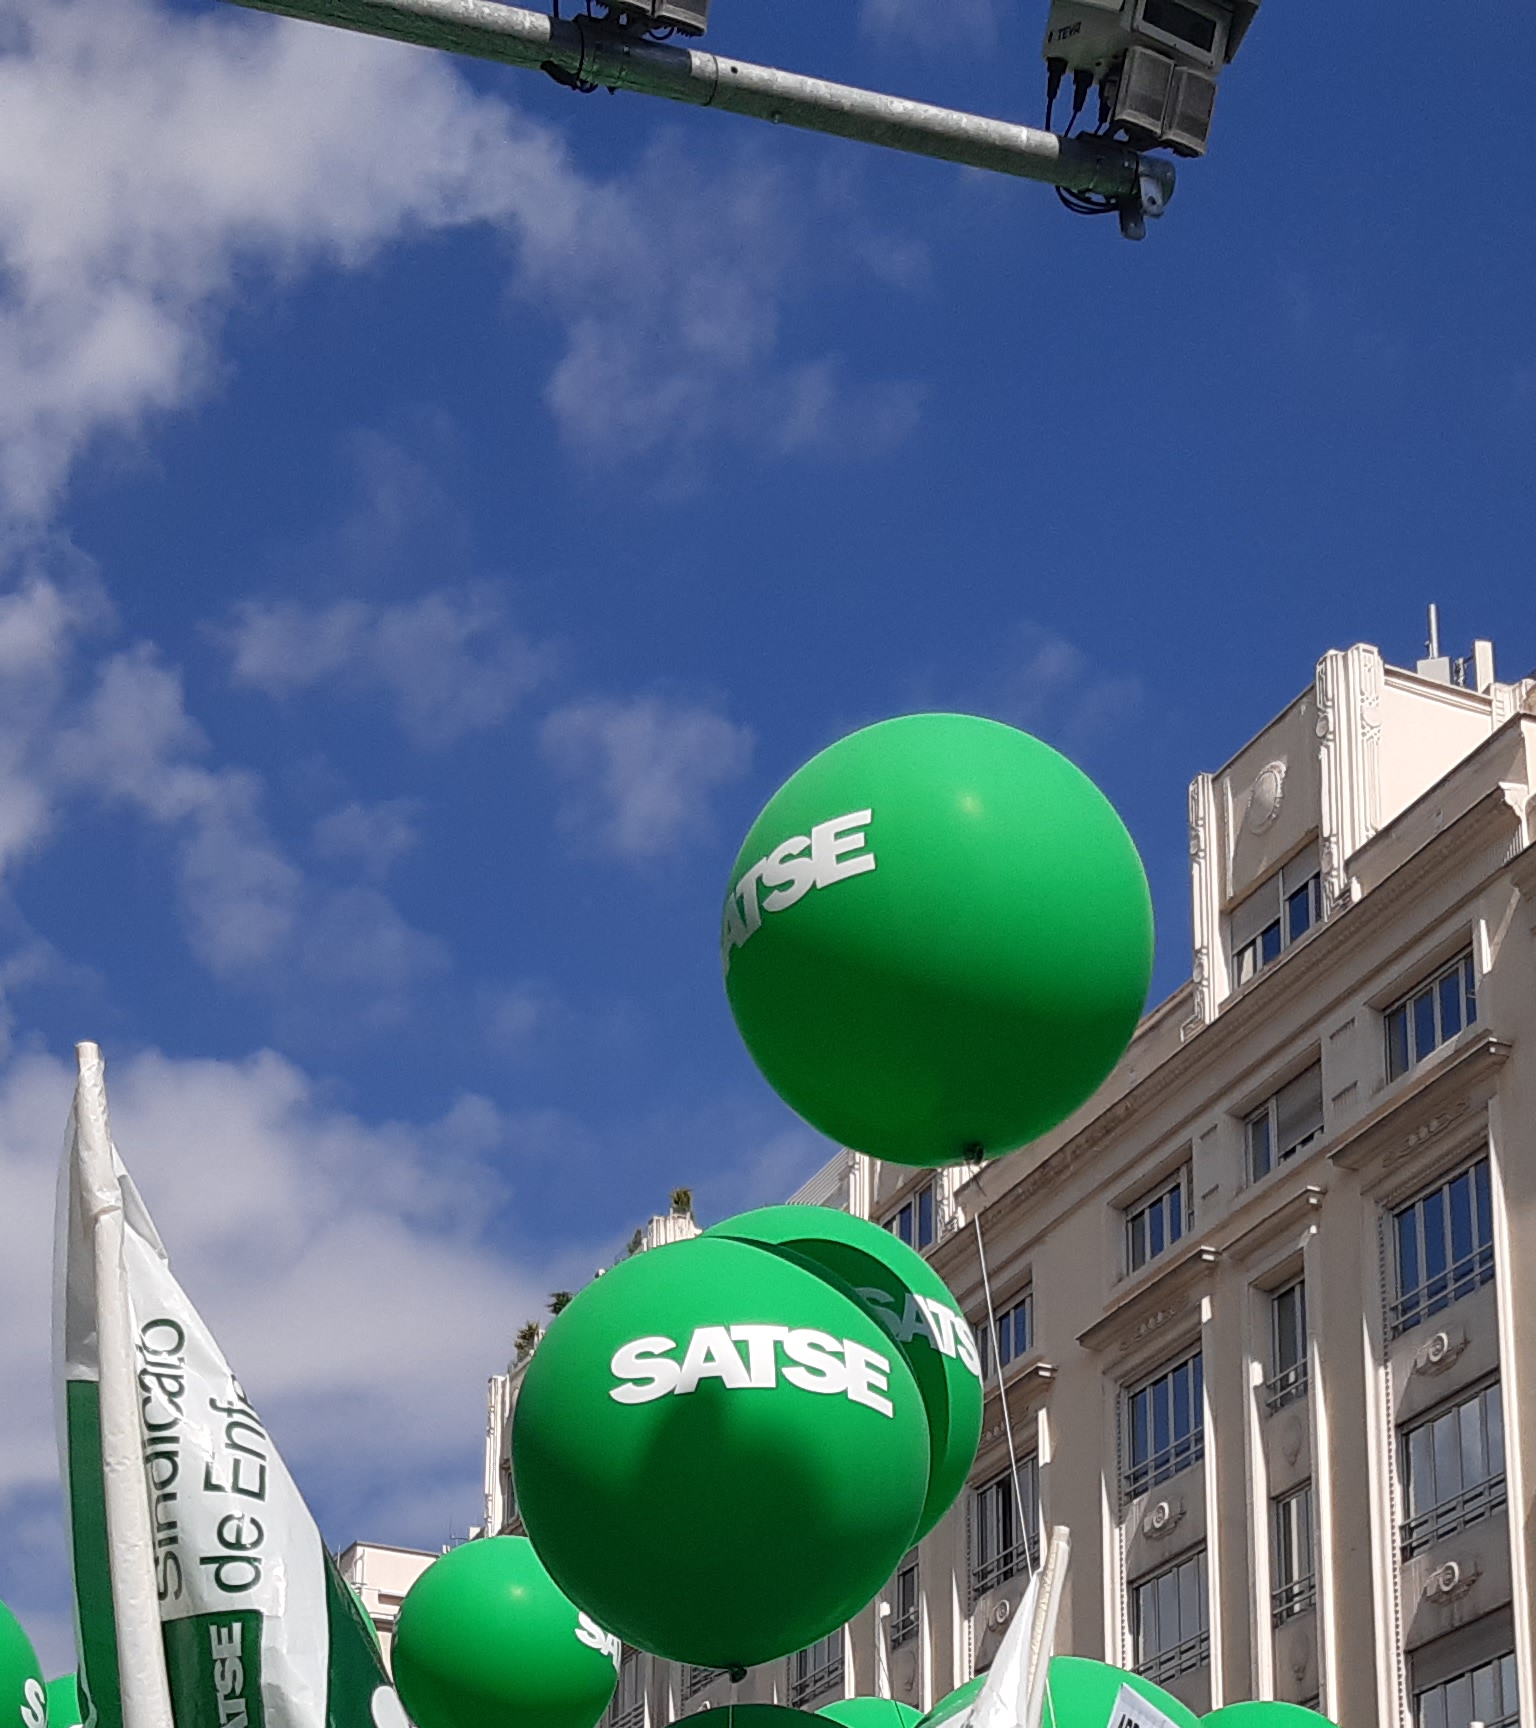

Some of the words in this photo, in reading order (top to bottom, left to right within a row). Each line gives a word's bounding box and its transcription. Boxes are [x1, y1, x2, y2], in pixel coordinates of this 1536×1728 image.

[721, 808, 877, 972] ATSE
[609, 1323, 895, 1418] SATSE
[198, 1510, 265, 1594] de
